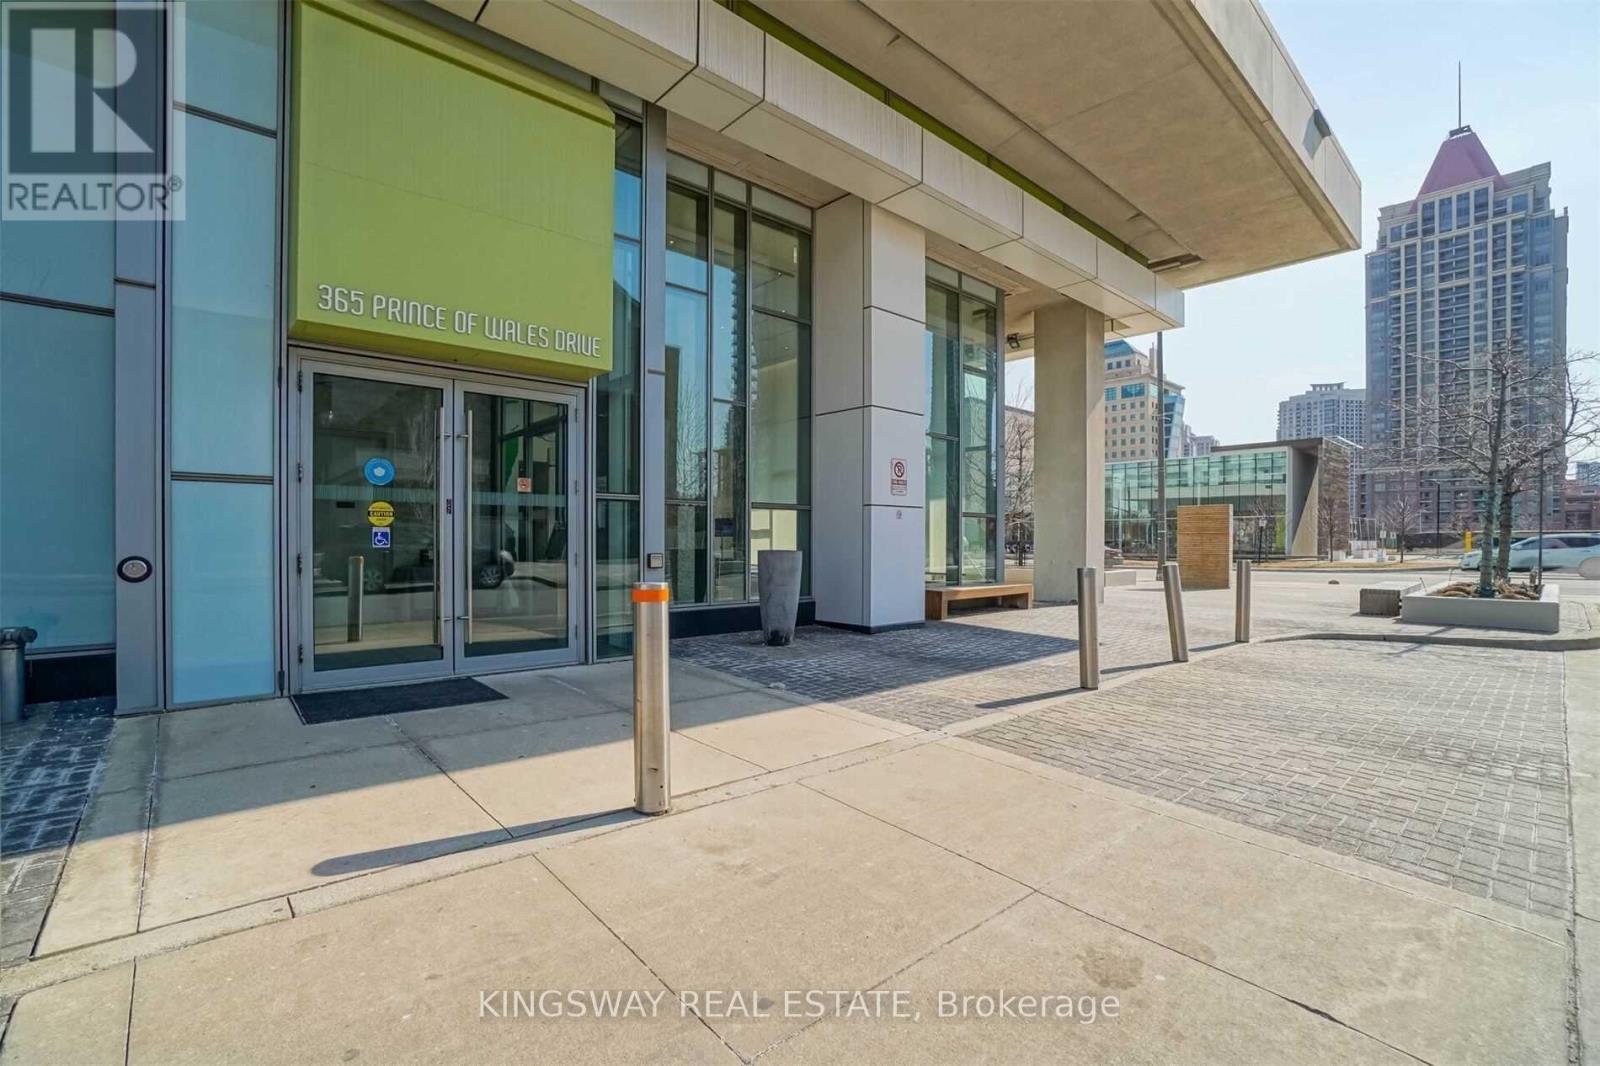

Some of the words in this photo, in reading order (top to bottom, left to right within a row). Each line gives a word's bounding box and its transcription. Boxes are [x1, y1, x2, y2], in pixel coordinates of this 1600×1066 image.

[317, 284, 364, 316] 365
[372, 294, 447, 330] PRINCE
[454, 310, 478, 335] OF
[484, 315, 549, 348] WALES
[555, 329, 601, 358] DRIVE
